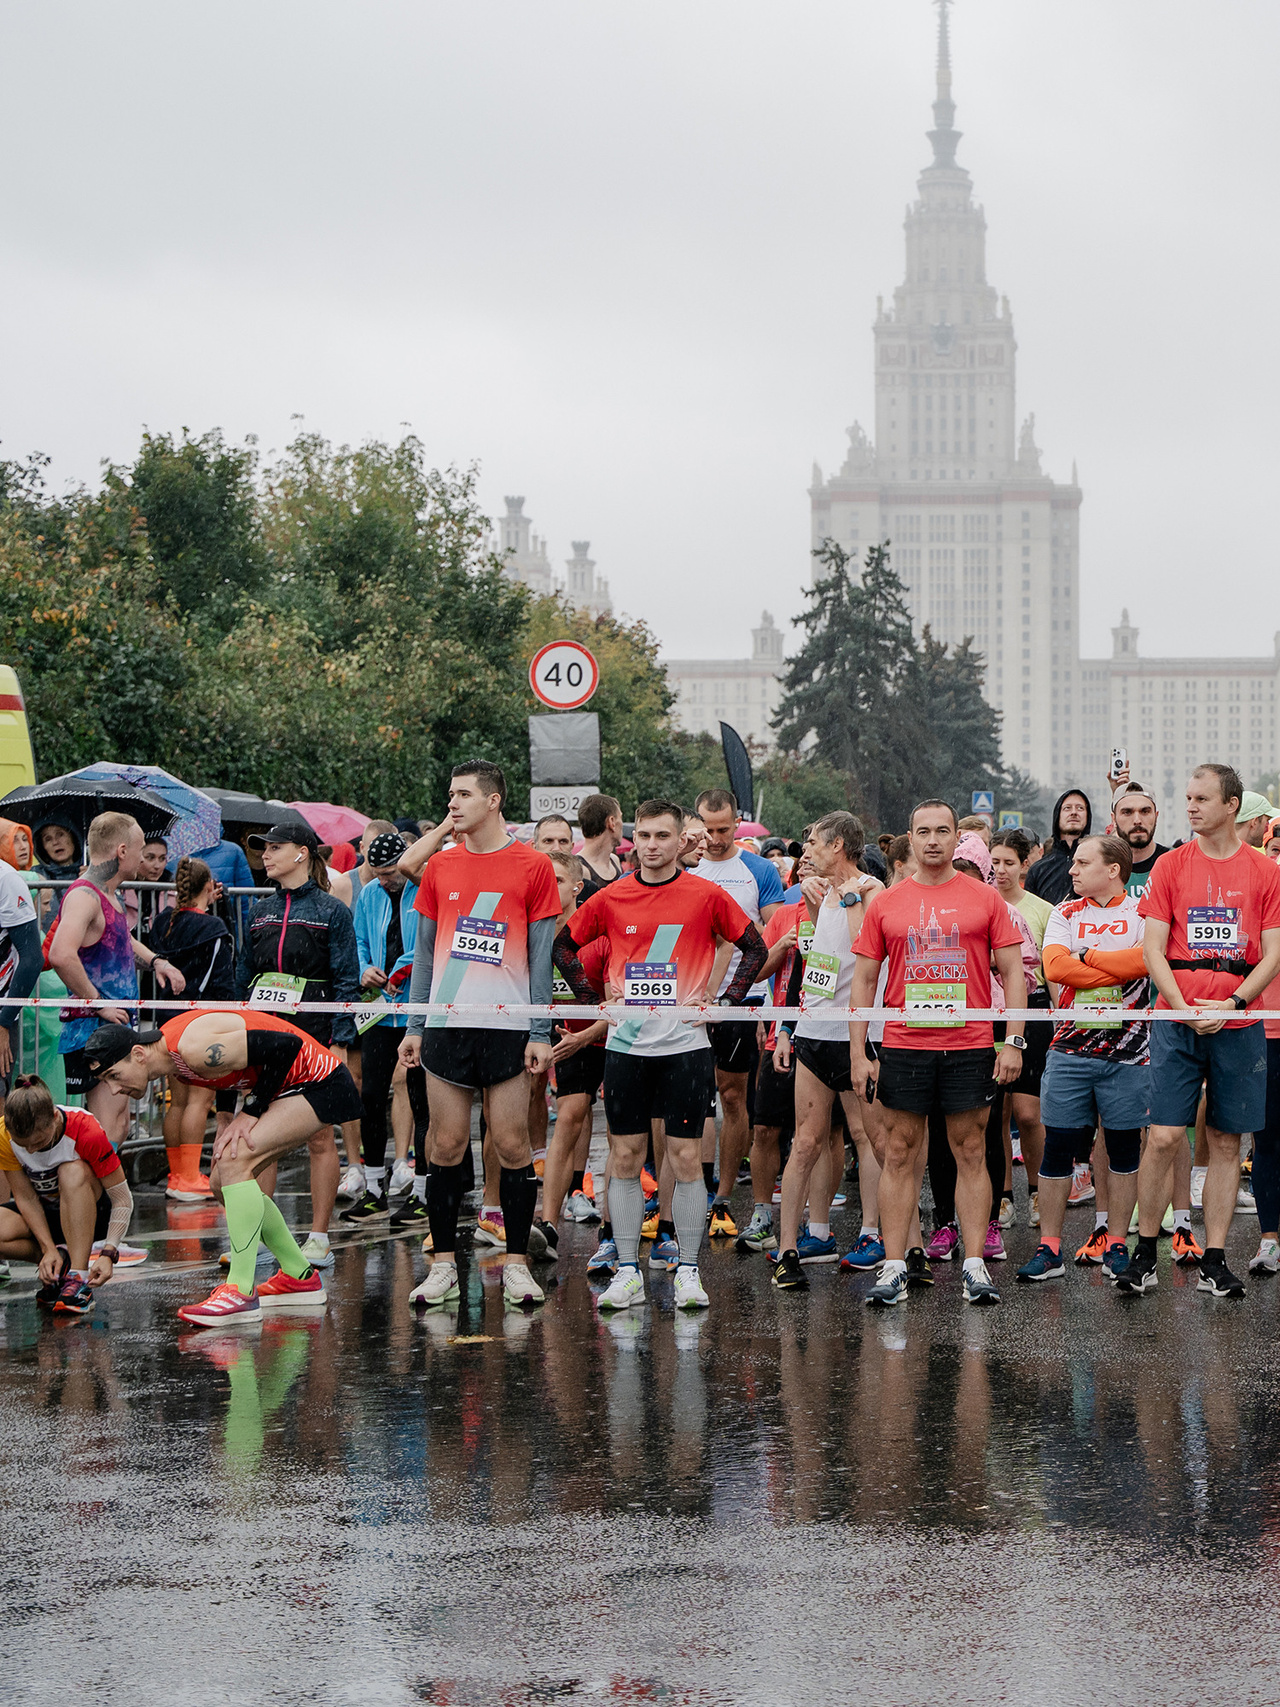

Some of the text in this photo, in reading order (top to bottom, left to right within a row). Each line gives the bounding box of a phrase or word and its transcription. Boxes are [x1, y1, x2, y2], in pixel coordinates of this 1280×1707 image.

[544, 662, 583, 687] 40
[539, 798, 549, 808] 10
[554, 797, 566, 809] 15
[1194, 926, 1232, 940] 5919
[457, 936, 500, 955] 5944
[807, 970, 831, 987] 4387
[256, 989, 288, 1003] 3215
[630, 982, 673, 996] 5969
